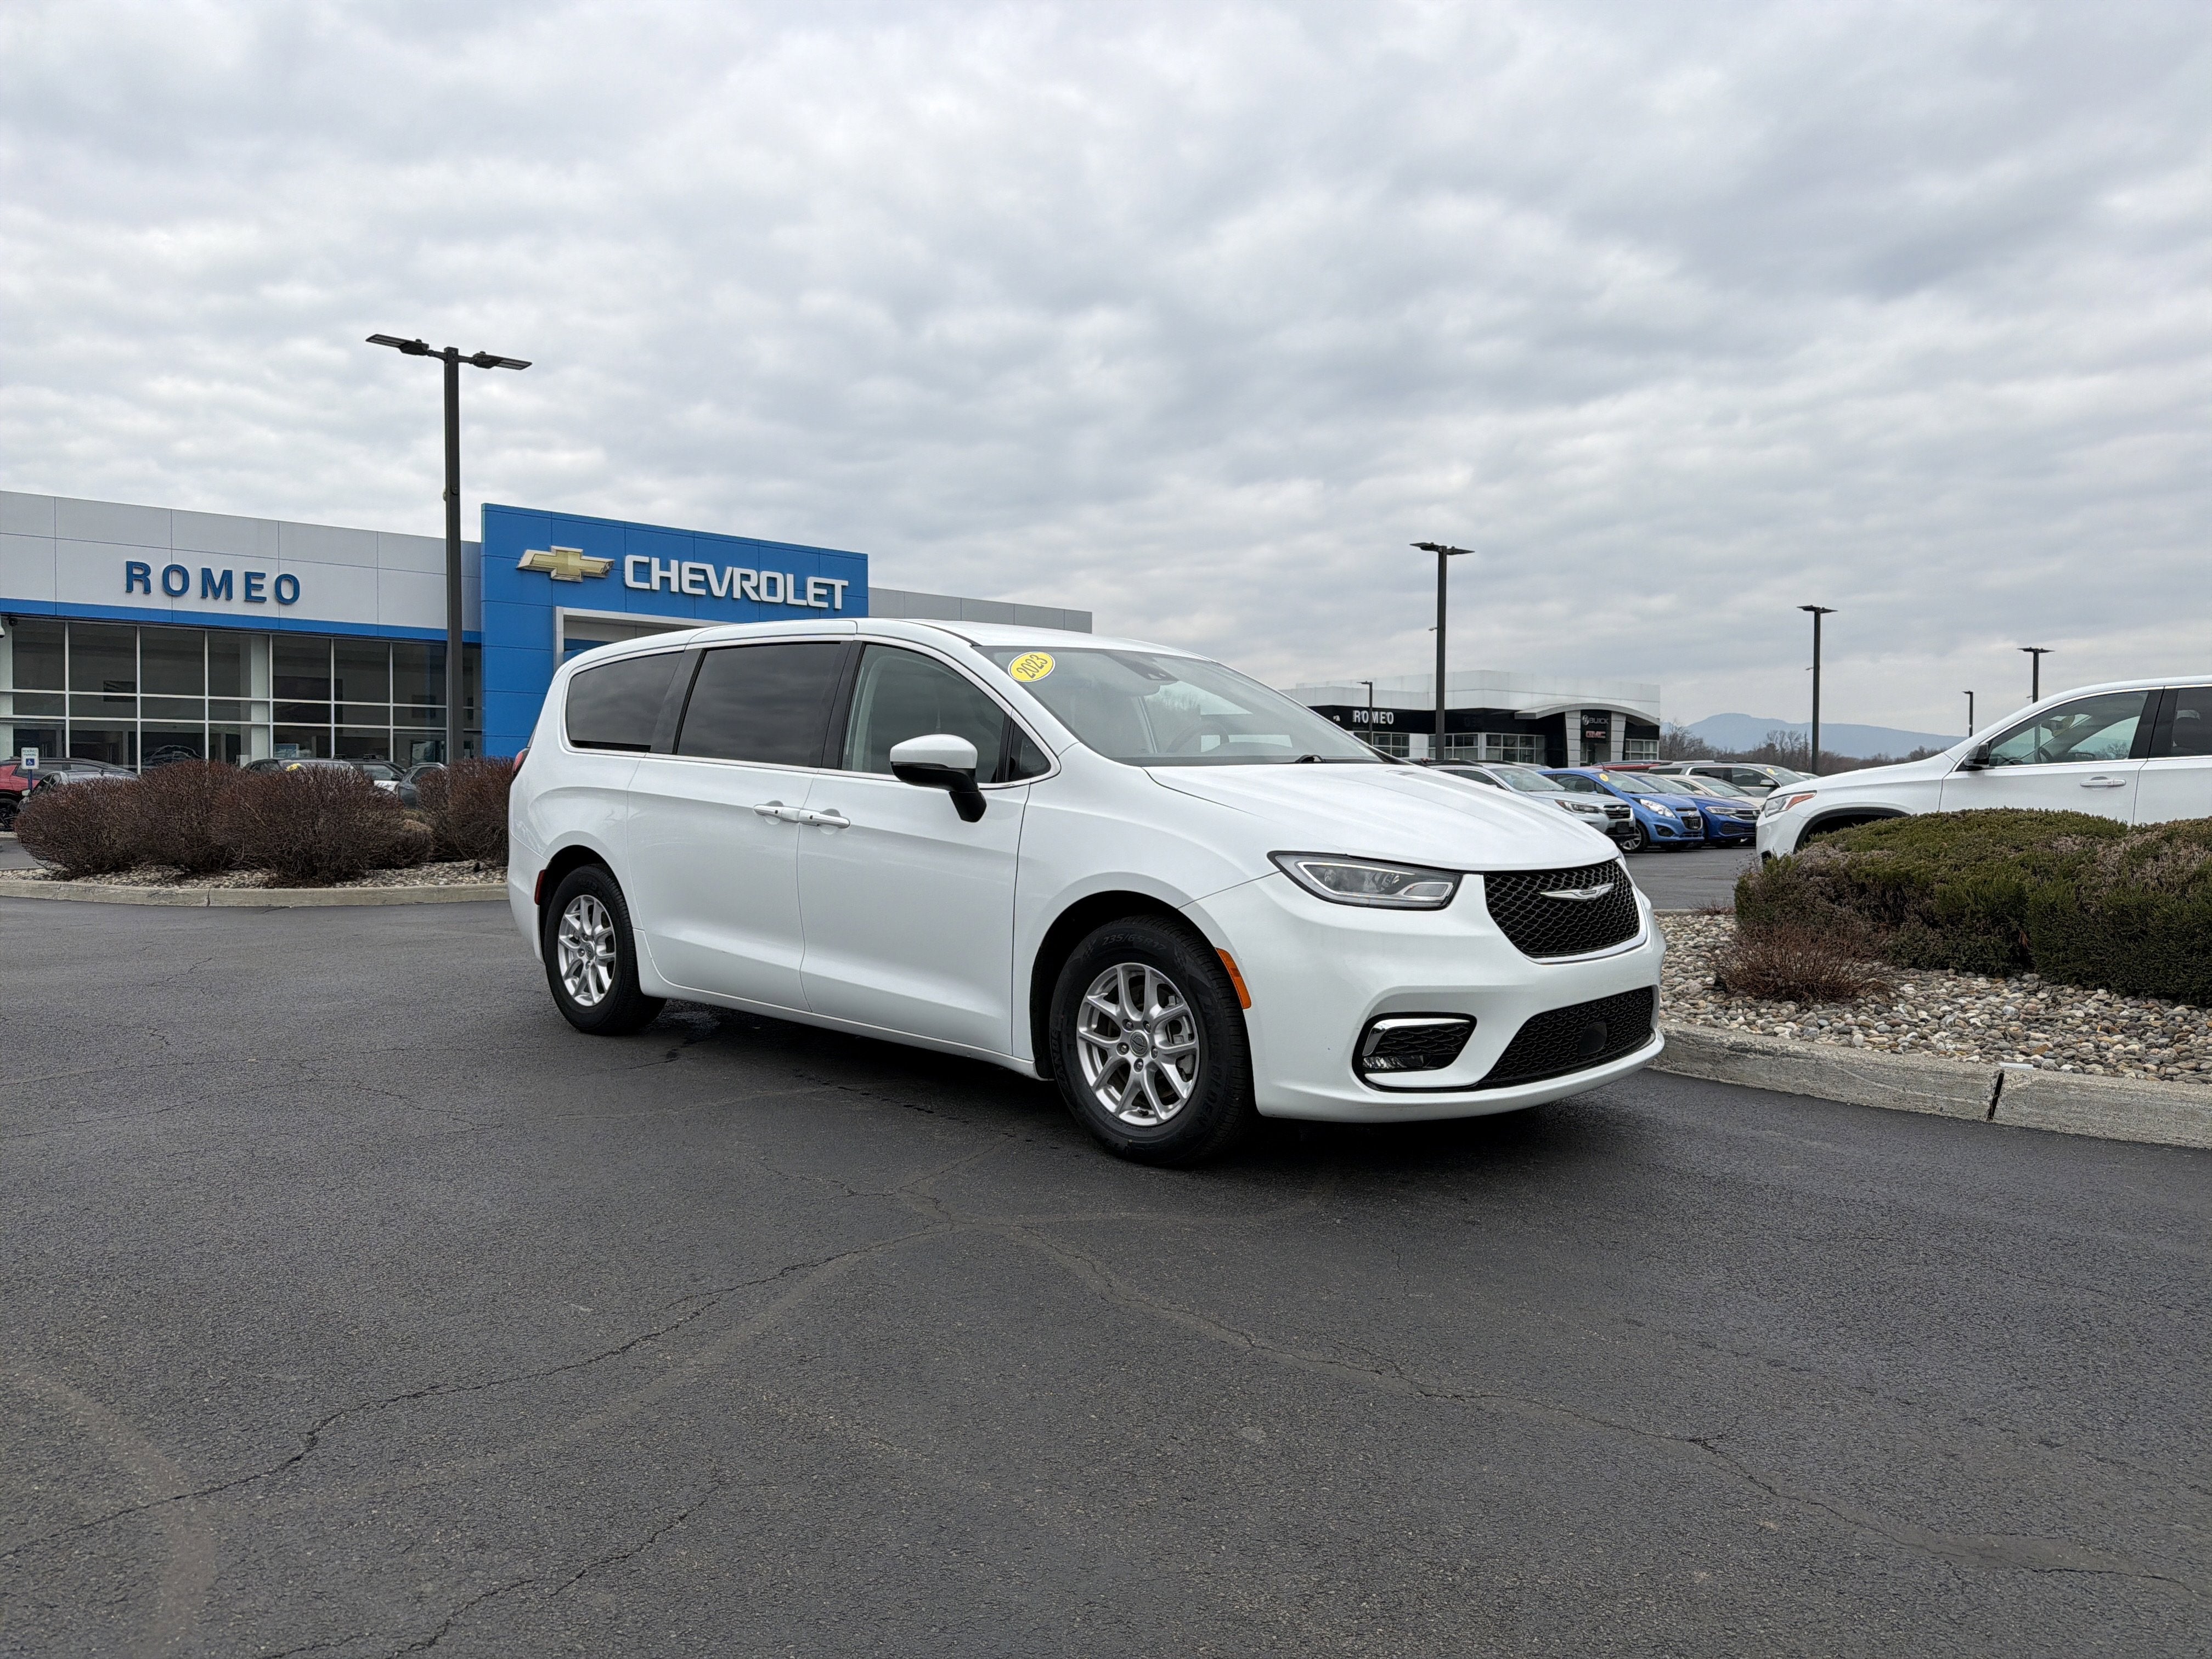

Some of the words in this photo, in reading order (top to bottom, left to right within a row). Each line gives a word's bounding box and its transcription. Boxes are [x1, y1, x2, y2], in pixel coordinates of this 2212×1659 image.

[126, 561, 300, 605] ROMEO
[625, 555, 849, 610] CHEVROLET
[1016, 654, 1048, 679] 2023
[1352, 710, 1394, 724] ROMEO
[1585, 730, 1606, 738] GMC
